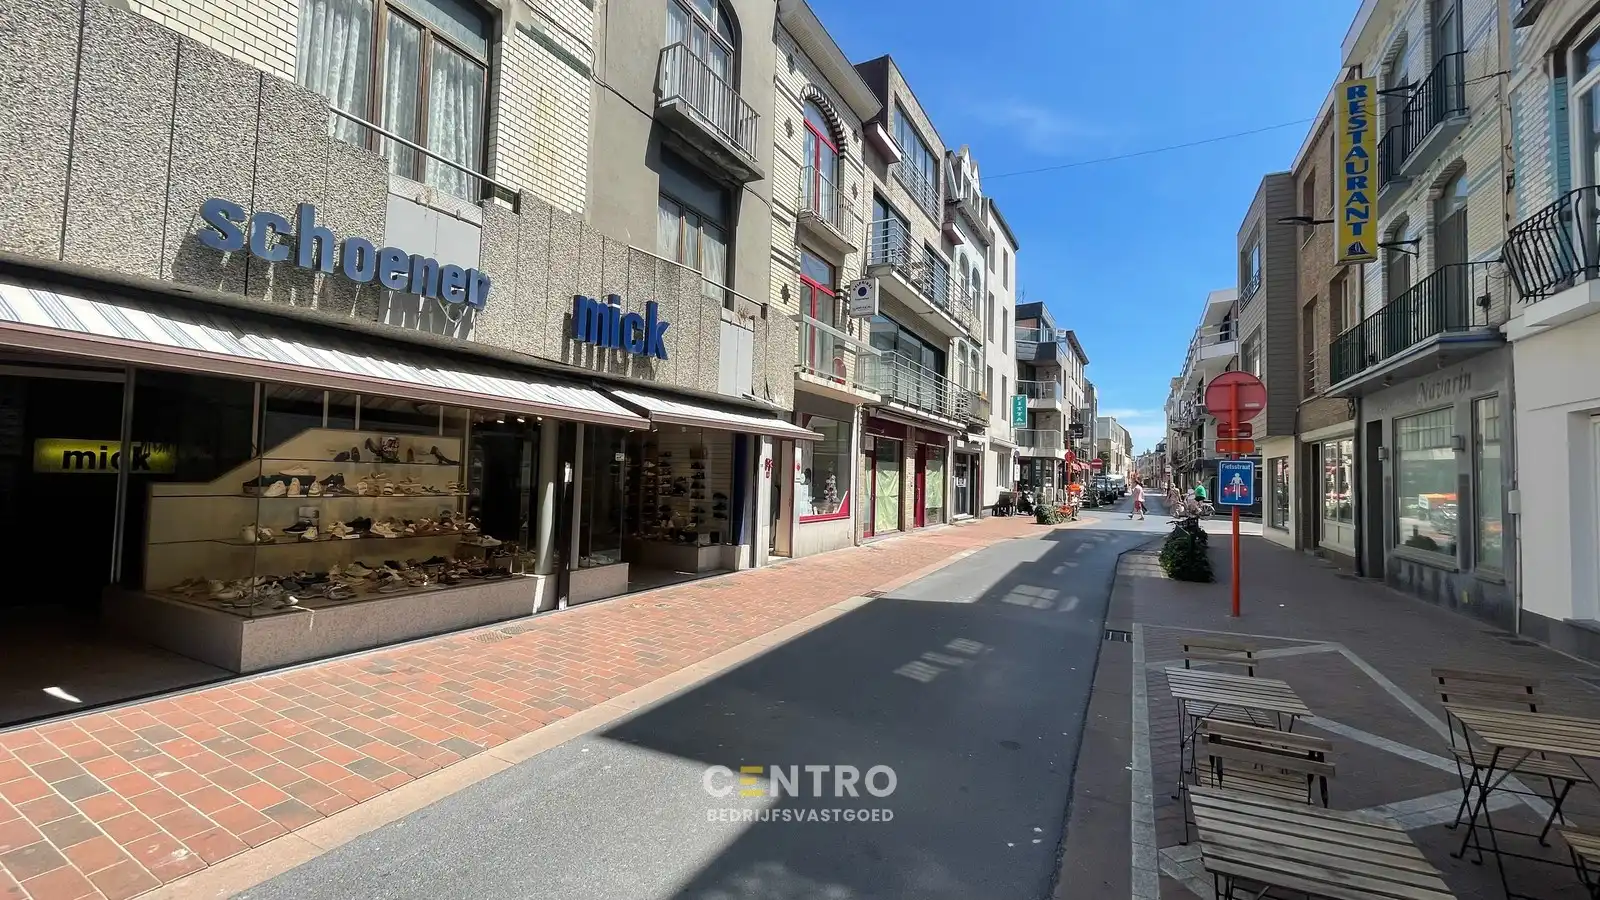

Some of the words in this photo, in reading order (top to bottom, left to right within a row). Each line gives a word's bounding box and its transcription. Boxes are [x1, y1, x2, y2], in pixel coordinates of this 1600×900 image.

[1344, 85, 1370, 236] RESTAURANT
[572, 293, 670, 360] mick
[1418, 367, 1472, 403] Navarin
[62, 445, 150, 471] mick
